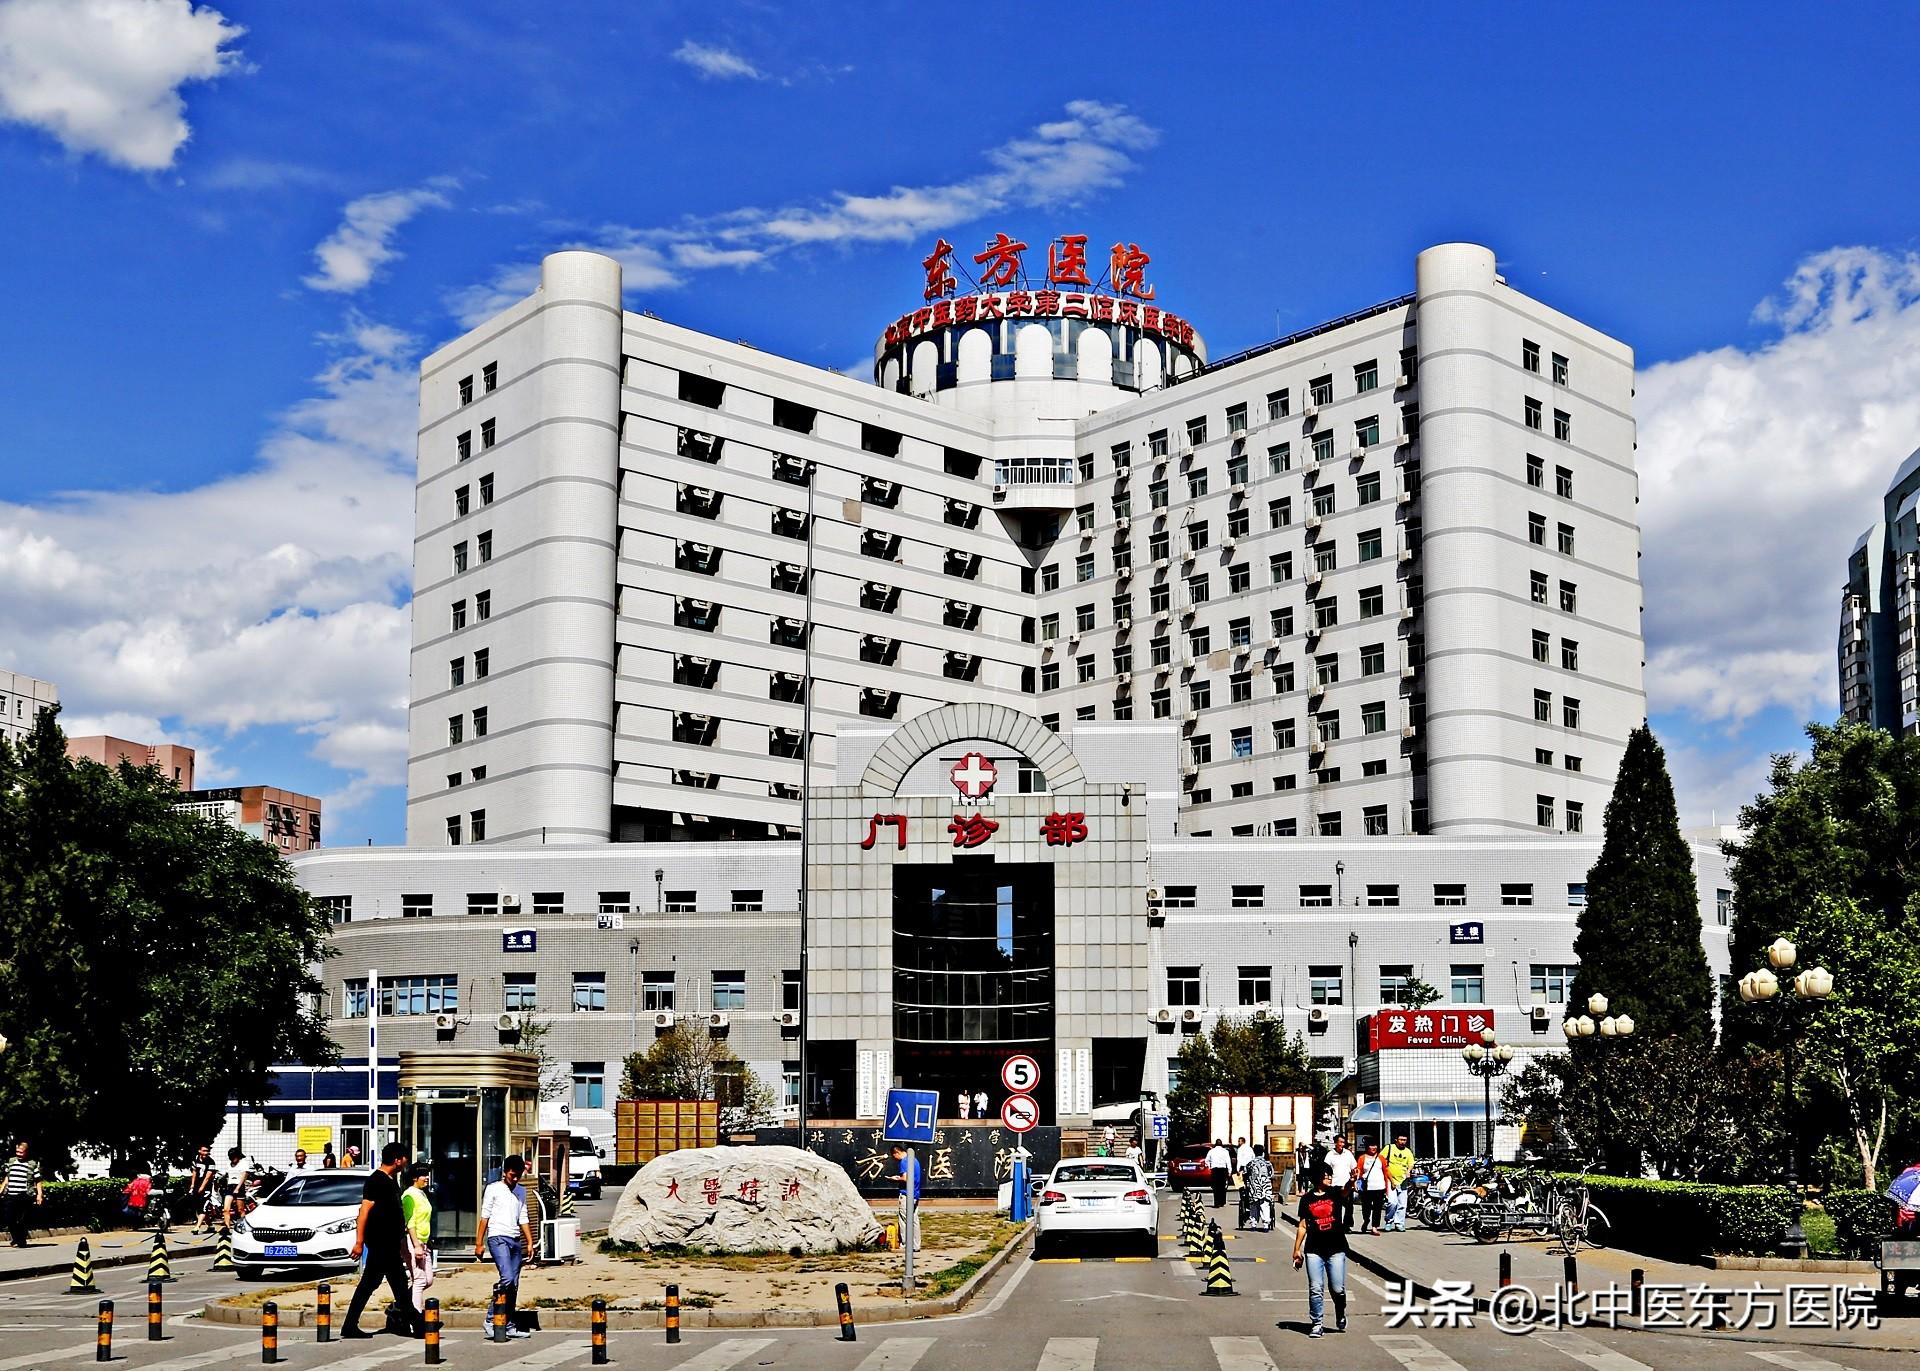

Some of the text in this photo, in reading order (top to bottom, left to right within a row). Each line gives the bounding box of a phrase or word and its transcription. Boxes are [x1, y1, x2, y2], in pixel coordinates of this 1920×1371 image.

[922, 232, 1155, 300] 东方医院
[884, 290, 1195, 351] 北京中医药大学第二临床医学院
[861, 812, 1088, 850] 门诊部
[1388, 1014, 1486, 1033] 发热门诊
[1440, 1036, 1467, 1044] Clinic
[1014, 1064, 1028, 1085] 5
[888, 1102, 933, 1129] 入口
[810, 1129, 1001, 1145] 北京中药大学
